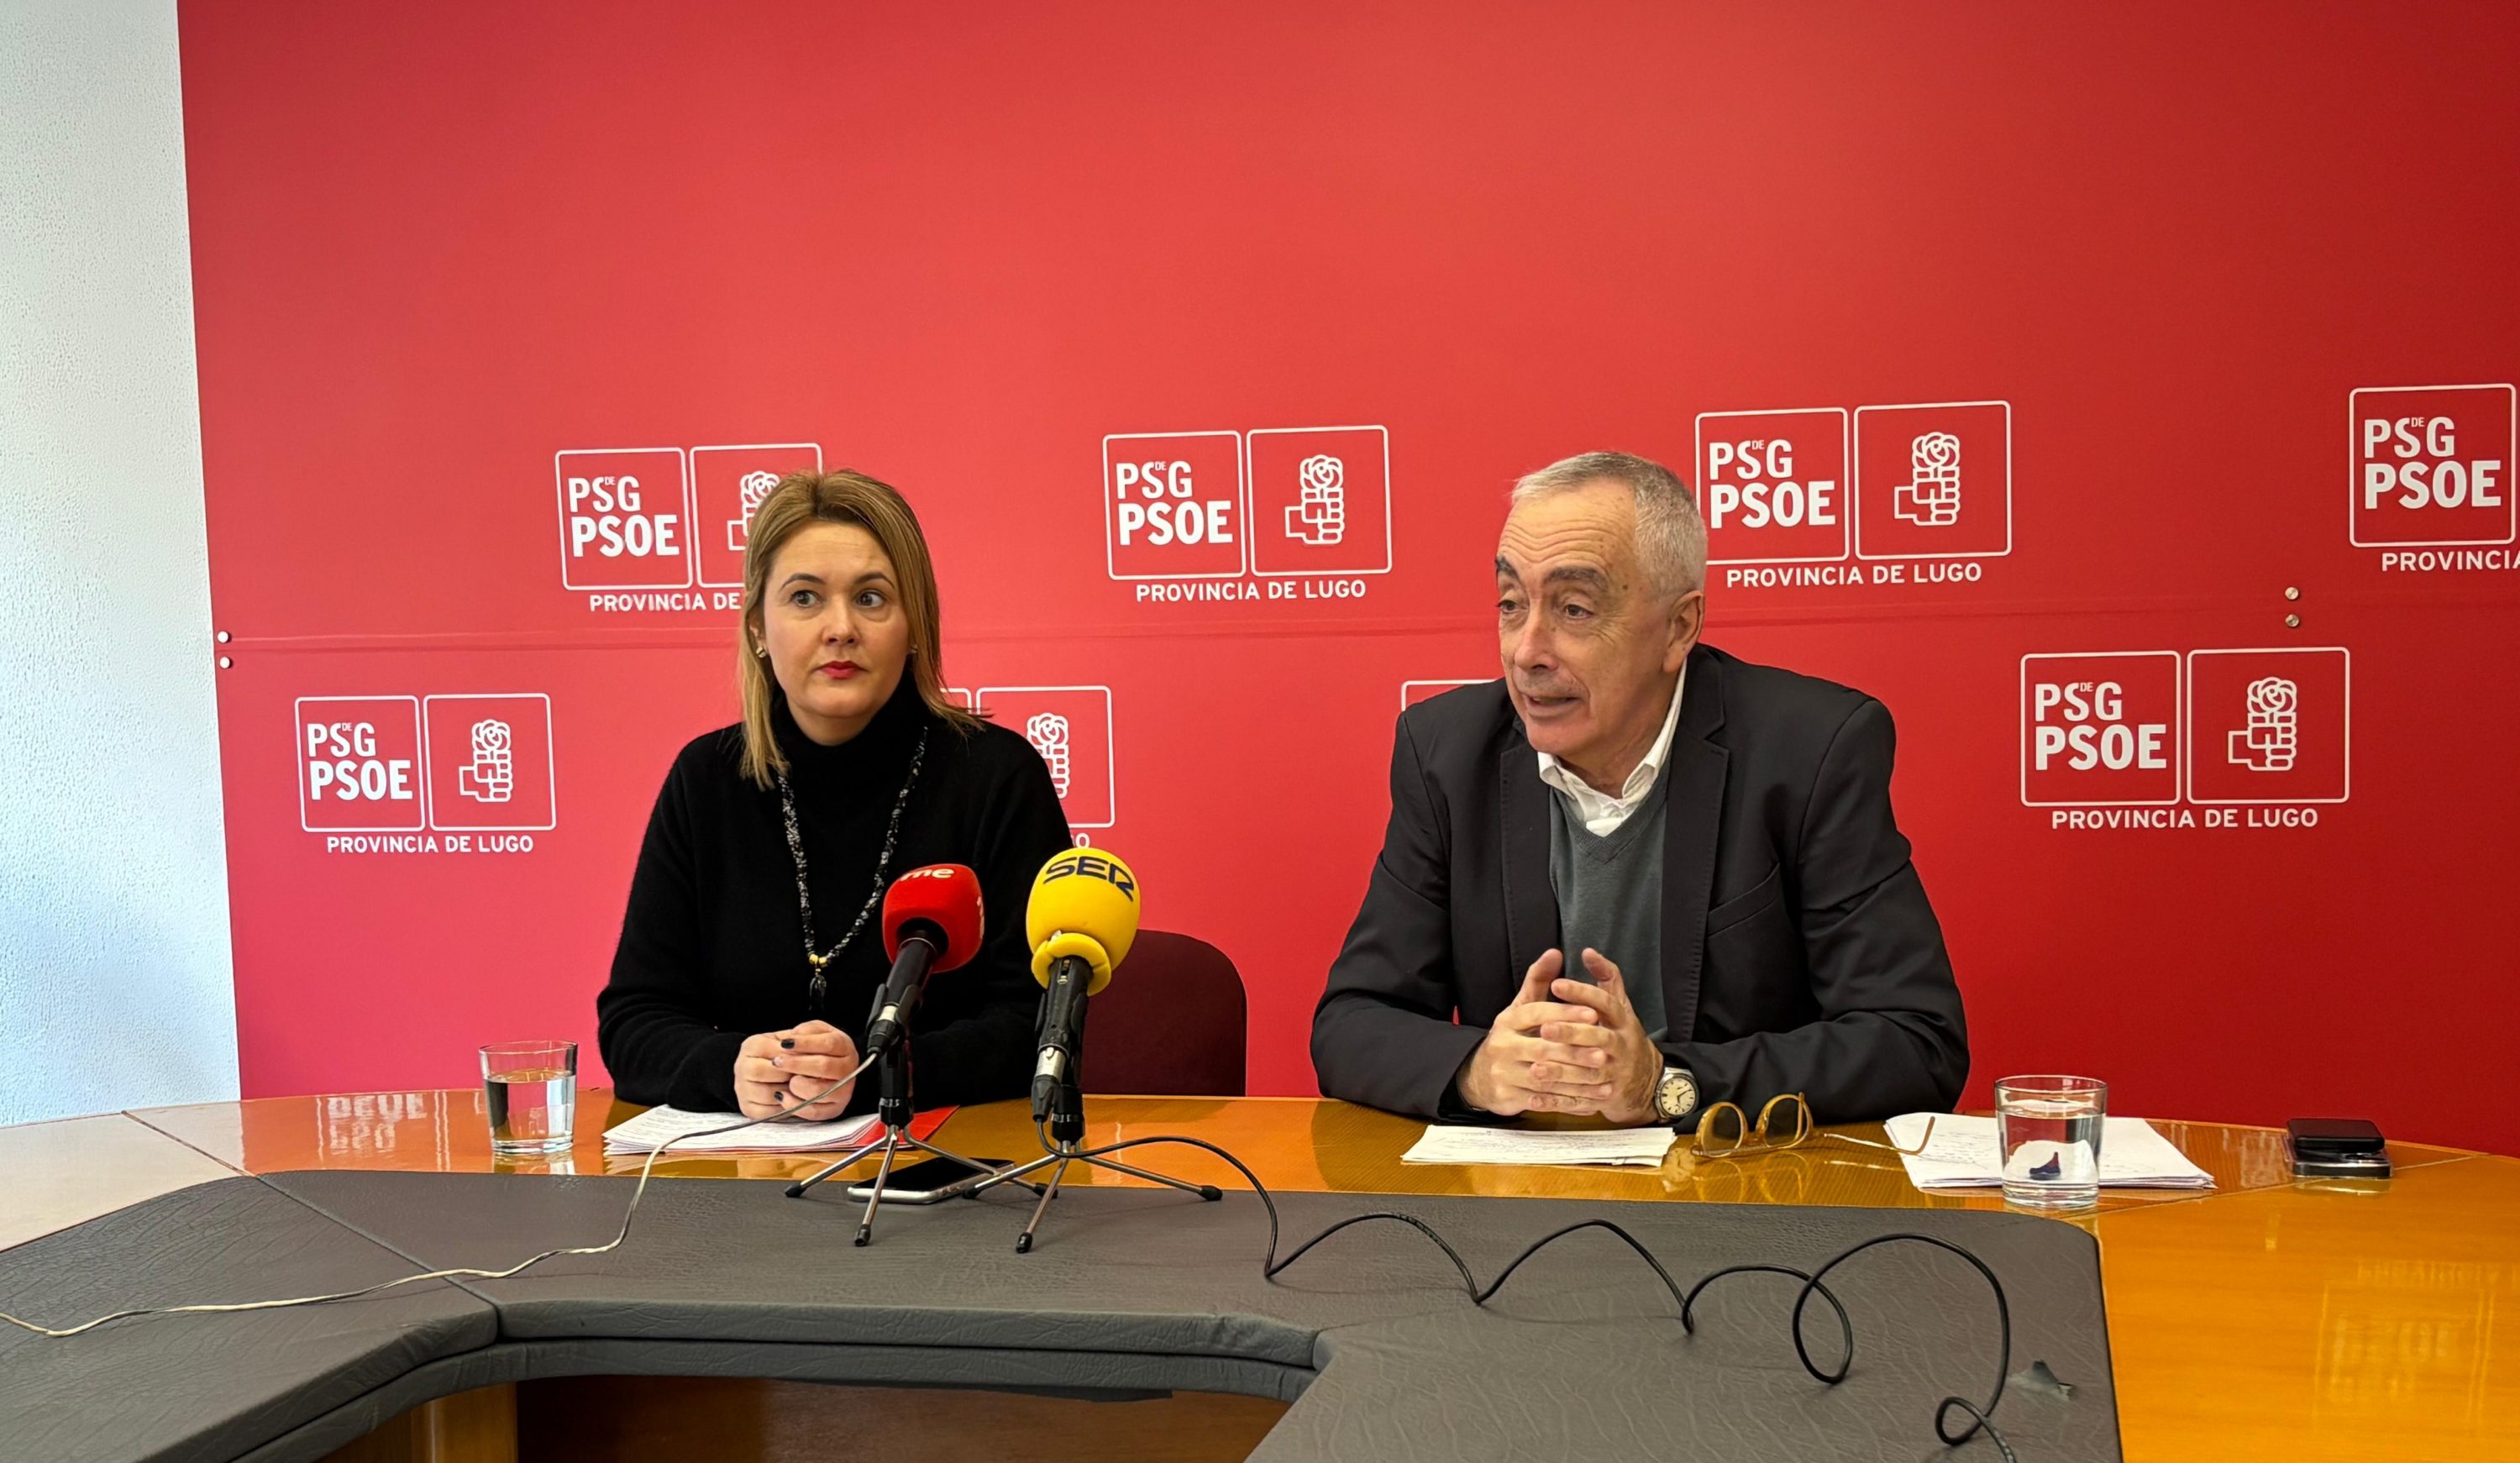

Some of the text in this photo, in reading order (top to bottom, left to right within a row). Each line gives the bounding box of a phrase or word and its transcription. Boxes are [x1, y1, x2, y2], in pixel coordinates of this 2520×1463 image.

[1710, 481, 1836, 529] PSOE
[2365, 460, 2502, 510] PSOE
[570, 514, 680, 558] PSOE
[1118, 501, 1233, 546] PSOE
[1136, 579, 1366, 602] PROVINCIA DE LUGO
[1726, 563, 1982, 588] PROVINCIA DE LUGO
[590, 592, 742, 612] PROVINCIA DE
[2035, 724, 2167, 771] PSOE
[309, 759, 413, 800] PSOE
[2052, 808, 2318, 830] PROVINCIA DE LUGO
[327, 835, 533, 853] PROVINCIA DE LUGO
[1042, 855, 1135, 902] SER
